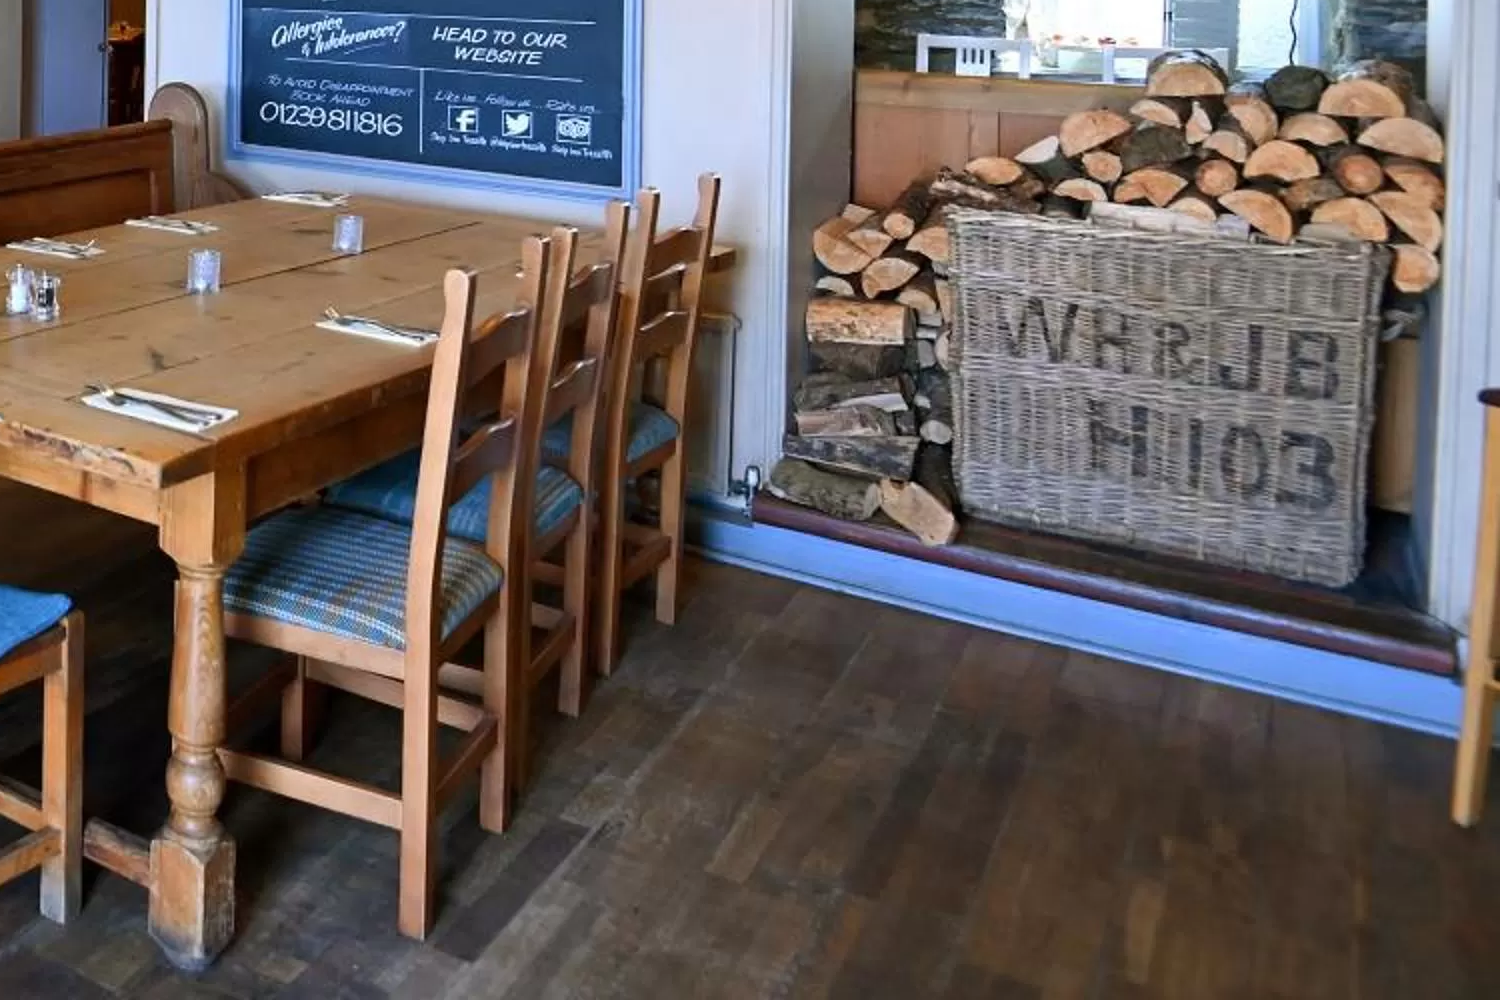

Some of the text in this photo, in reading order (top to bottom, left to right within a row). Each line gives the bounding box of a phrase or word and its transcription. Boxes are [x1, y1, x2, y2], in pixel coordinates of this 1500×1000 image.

[272, 15, 343, 47] Allergies
[432, 26, 568, 49] HEAD TO OUR
[454, 46, 543, 65] WEBSITE
